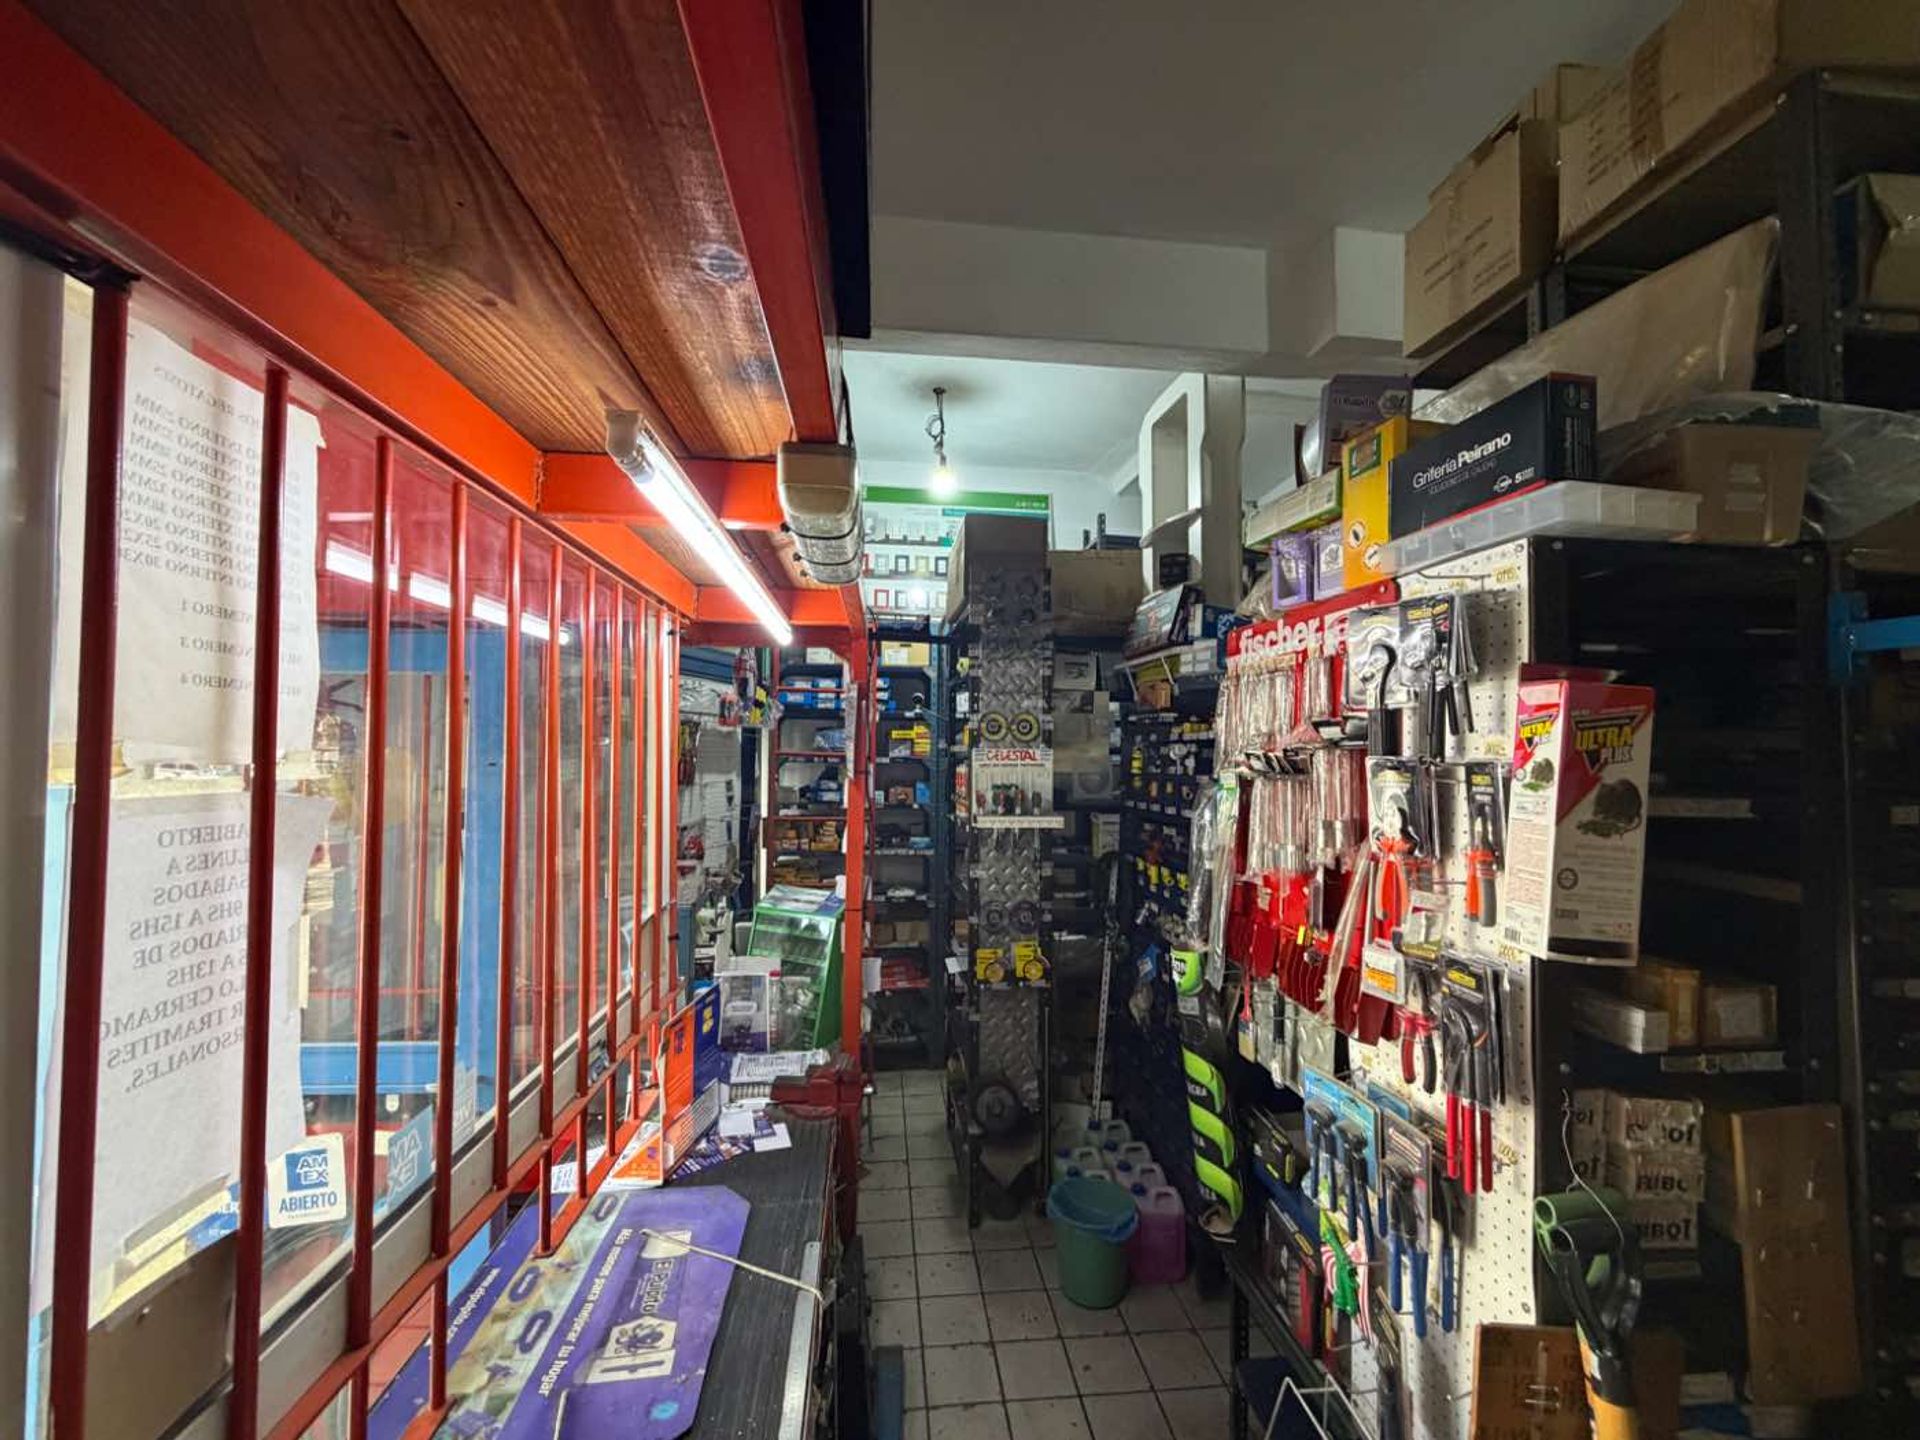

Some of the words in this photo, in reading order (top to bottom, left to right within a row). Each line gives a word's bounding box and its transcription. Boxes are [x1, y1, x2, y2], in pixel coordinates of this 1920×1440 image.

[1457, 433, 1512, 468] Peirano
[1239, 617, 1323, 658] fischer
[1575, 727, 1634, 750] ULTRA
[1600, 745, 1634, 764] PLUS
[279, 1190, 338, 1214] ABIERTO
[587, 1277, 606, 1301] para
[567, 1301, 595, 1342] mejorar
[558, 1345, 575, 1358] tu
[538, 1359, 568, 1397] hogar
